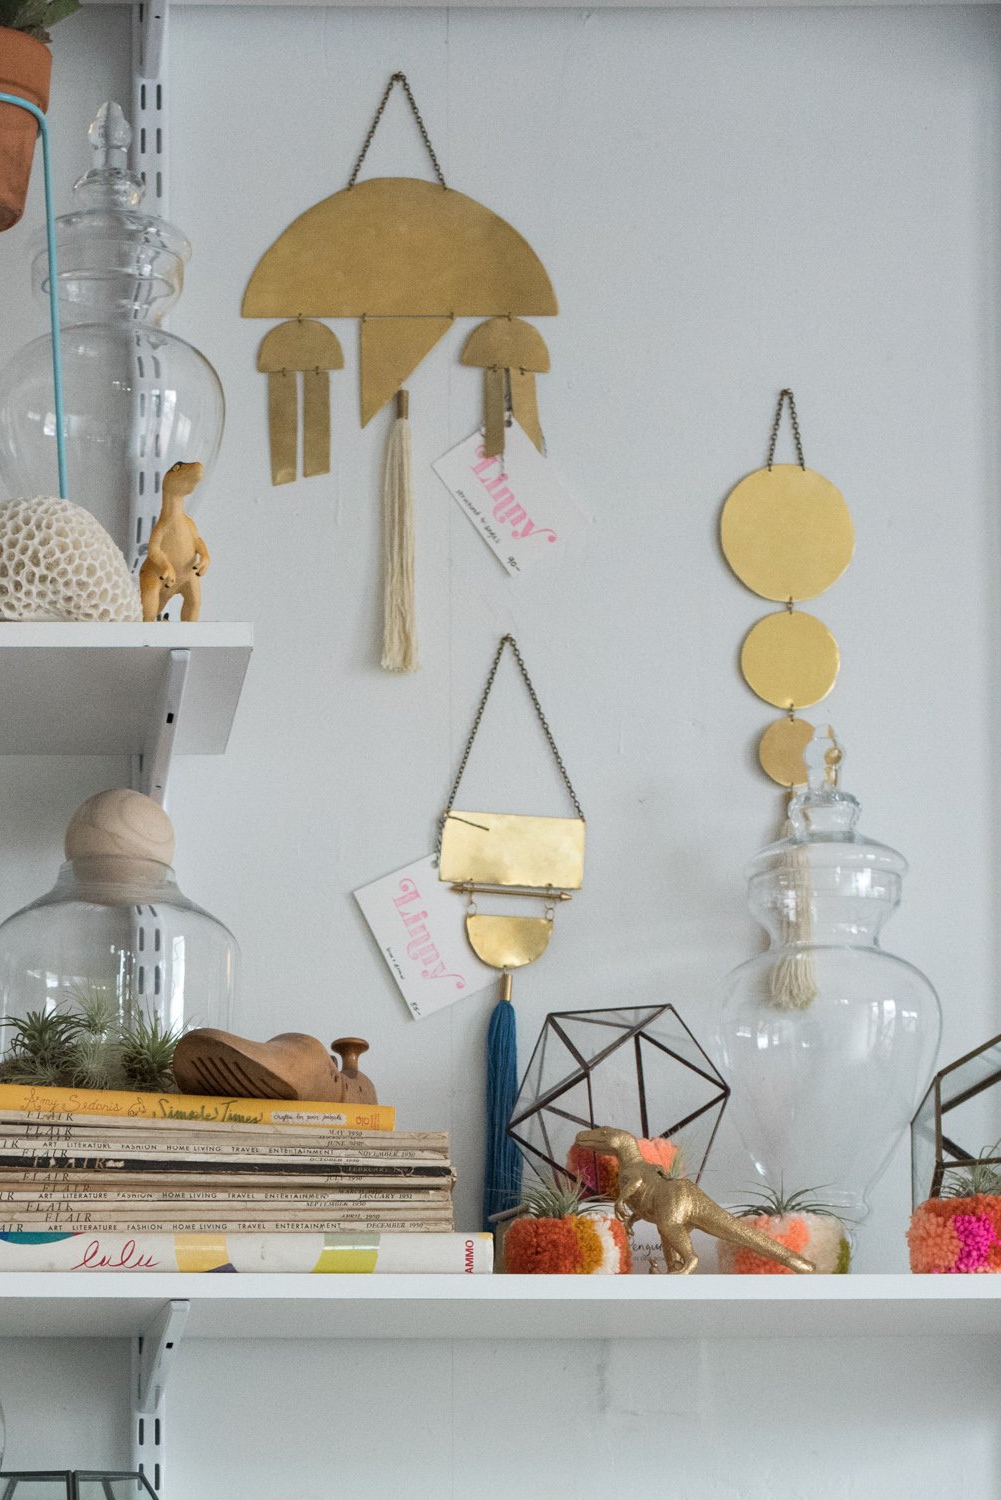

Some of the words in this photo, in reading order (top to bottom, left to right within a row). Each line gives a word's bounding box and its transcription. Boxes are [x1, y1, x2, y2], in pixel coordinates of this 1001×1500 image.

[471, 444, 557, 543] Linny
[392, 878, 465, 989] Linny
[21, 1088, 58, 1112] Amy
[222, 1099, 264, 1124] Times
[27, 1111, 73, 1121] FLAIR
[25, 1125, 73, 1136] FLAIR
[21, 1149, 68, 1158] FLAIR
[22, 1172, 69, 1181] FLAIR
[42, 1184, 90, 1193] FLAIR
[358, 1193, 396, 1201] JANUARY
[26, 1202, 73, 1212] FLAIR
[45, 1213, 92, 1222] FLAIR
[70, 1239, 161, 1270] lulu
[465, 1240, 474, 1274] AMMO
